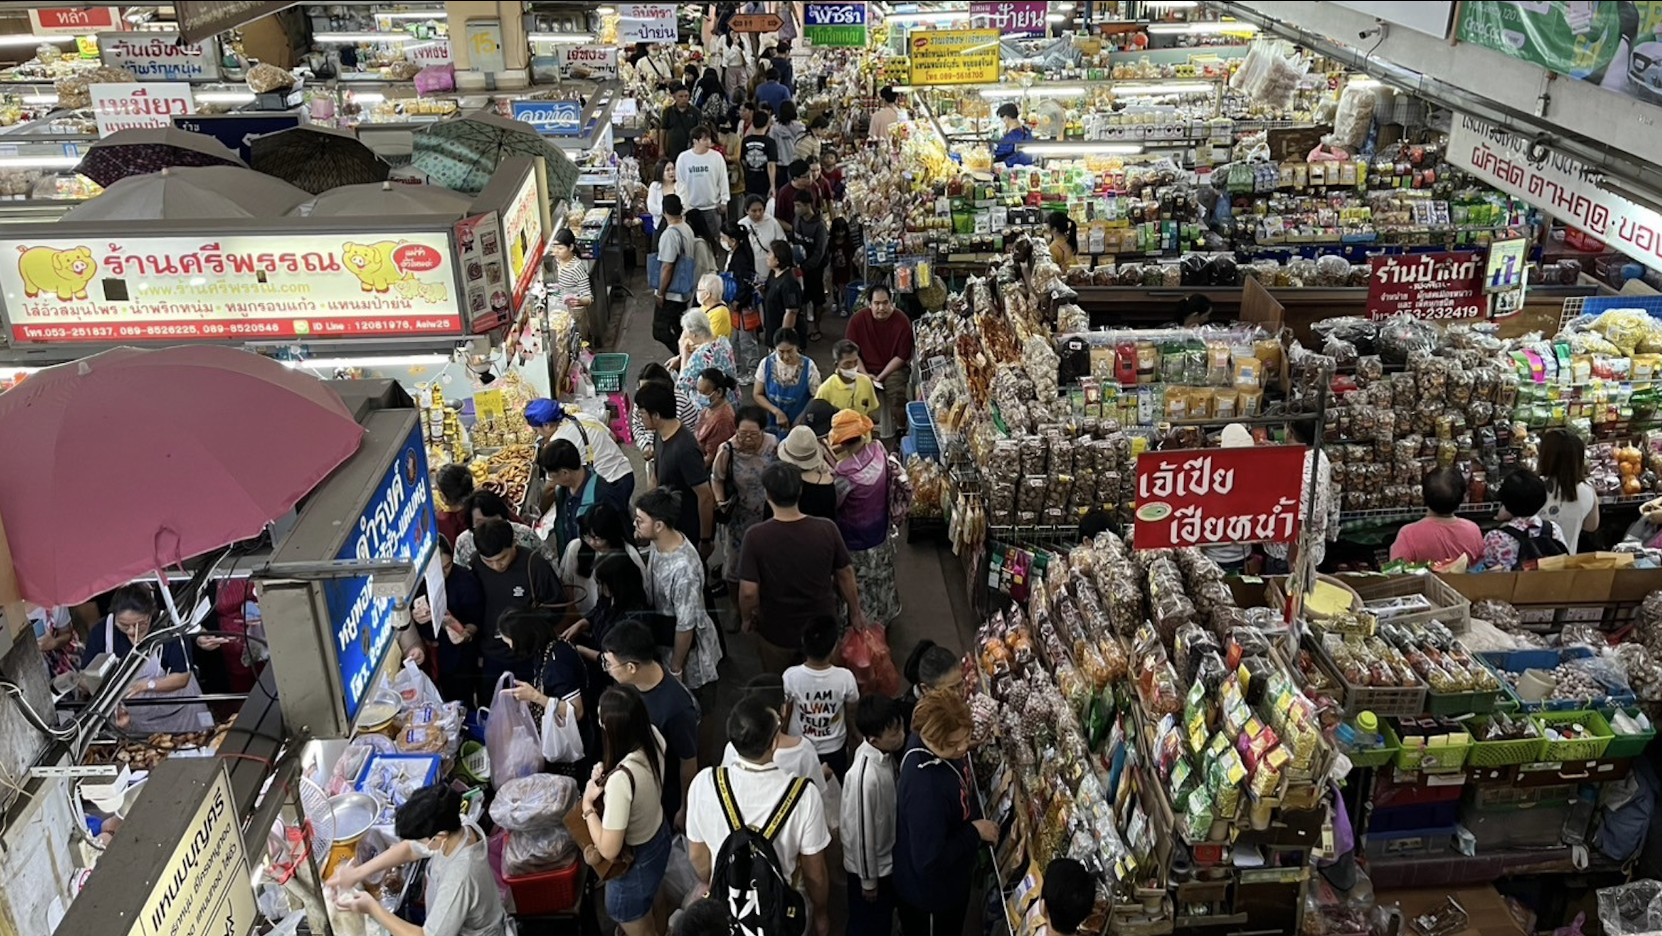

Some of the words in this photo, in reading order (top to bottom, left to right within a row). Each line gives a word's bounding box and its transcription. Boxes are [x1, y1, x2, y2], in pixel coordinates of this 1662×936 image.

[470, 31, 496, 54] 15
[638, 23, 676, 39] ป้าย่น
[99, 88, 188, 116] เหมียว
[1471, 142, 1525, 188] ผักสด
[103, 241, 341, 276] ร้านศรีพรรณ
[22, 299, 119, 320] ไส้อั่วสมุนไพร
[130, 297, 214, 317] น้ำพริกหนุ่ม
[225, 297, 316, 317] หมูกรอบแก้ว
[327, 296, 412, 312] แหนมป้าย่น
[312, 322, 323, 331] ID
[1140, 455, 1235, 498] เจ้เปีย
[1170, 496, 1297, 544] เฮียหน้ำ
[806, 692, 810, 701] I
[814, 689, 832, 701] AM
[802, 724, 831, 737] SMILE
[151, 786, 225, 933] แหนมบุญศรี
